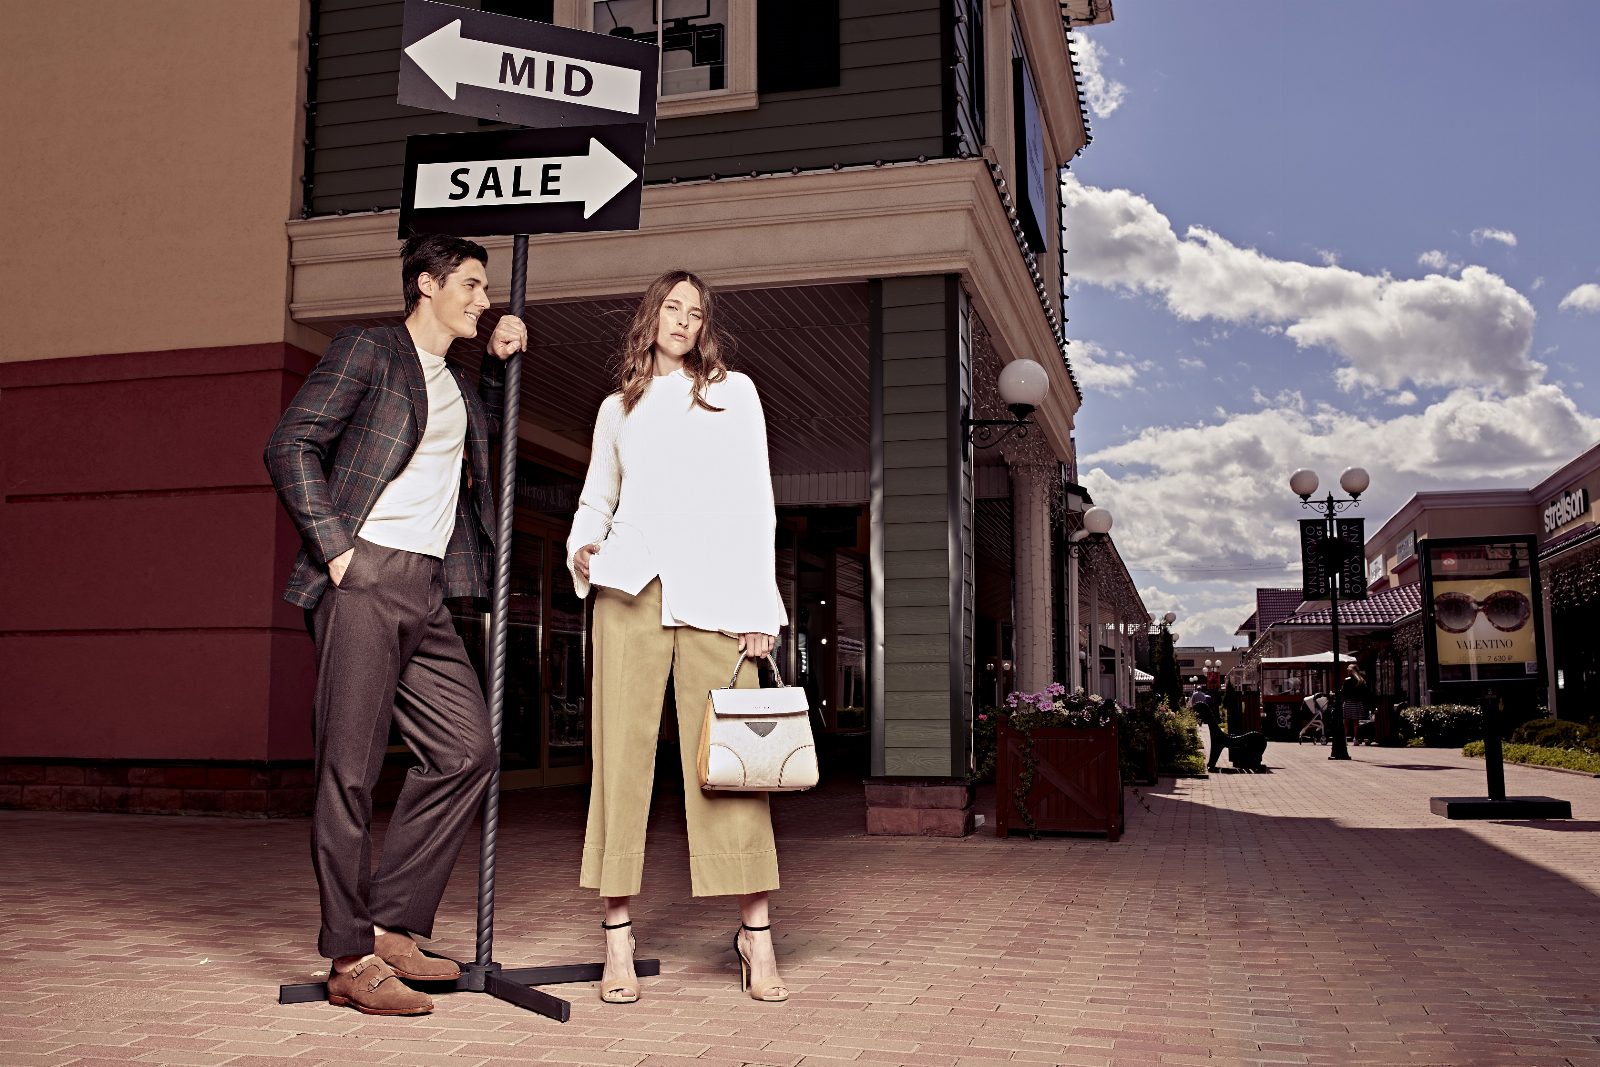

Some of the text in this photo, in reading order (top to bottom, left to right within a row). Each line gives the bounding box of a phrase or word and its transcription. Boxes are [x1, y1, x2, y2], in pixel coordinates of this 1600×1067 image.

[499, 52, 594, 97] MID
[448, 163, 562, 200] SALE
[517, 475, 547, 507] illeroy
[1350, 524, 1362, 594] VNKOVO
[1456, 639, 1513, 650] VALENTINO
